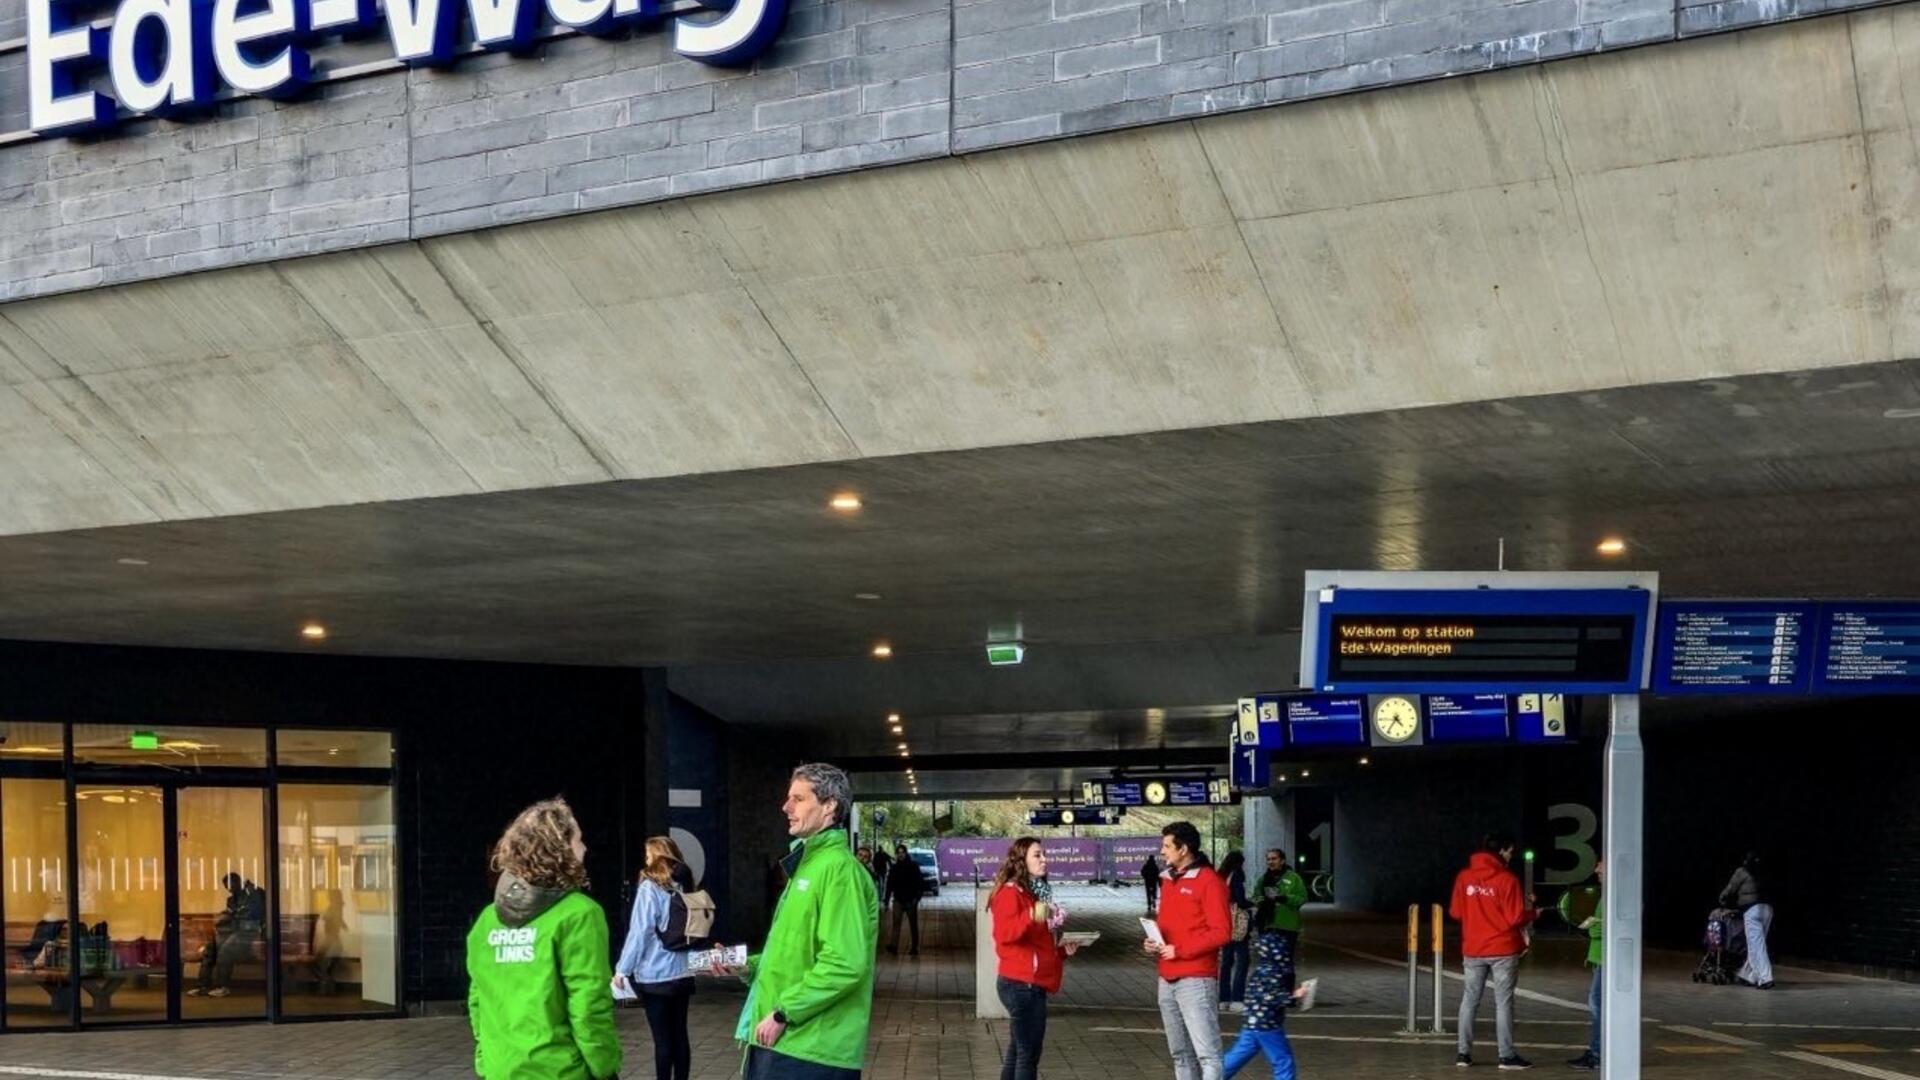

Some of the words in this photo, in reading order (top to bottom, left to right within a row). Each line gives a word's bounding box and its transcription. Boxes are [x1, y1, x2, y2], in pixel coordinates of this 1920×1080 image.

[1340, 625, 1397, 637] Welkom
[1402, 628, 1420, 639] op
[1425, 625, 1475, 637] station
[1340, 641, 1452, 656] Ede-Wageningen
[1263, 708, 1272, 720] 5
[1524, 700, 1534, 711] 5
[1308, 821, 1331, 872] 1
[1544, 803, 1597, 884] 3
[487, 927, 537, 946] GROEN
[495, 945, 536, 964] LINKS
